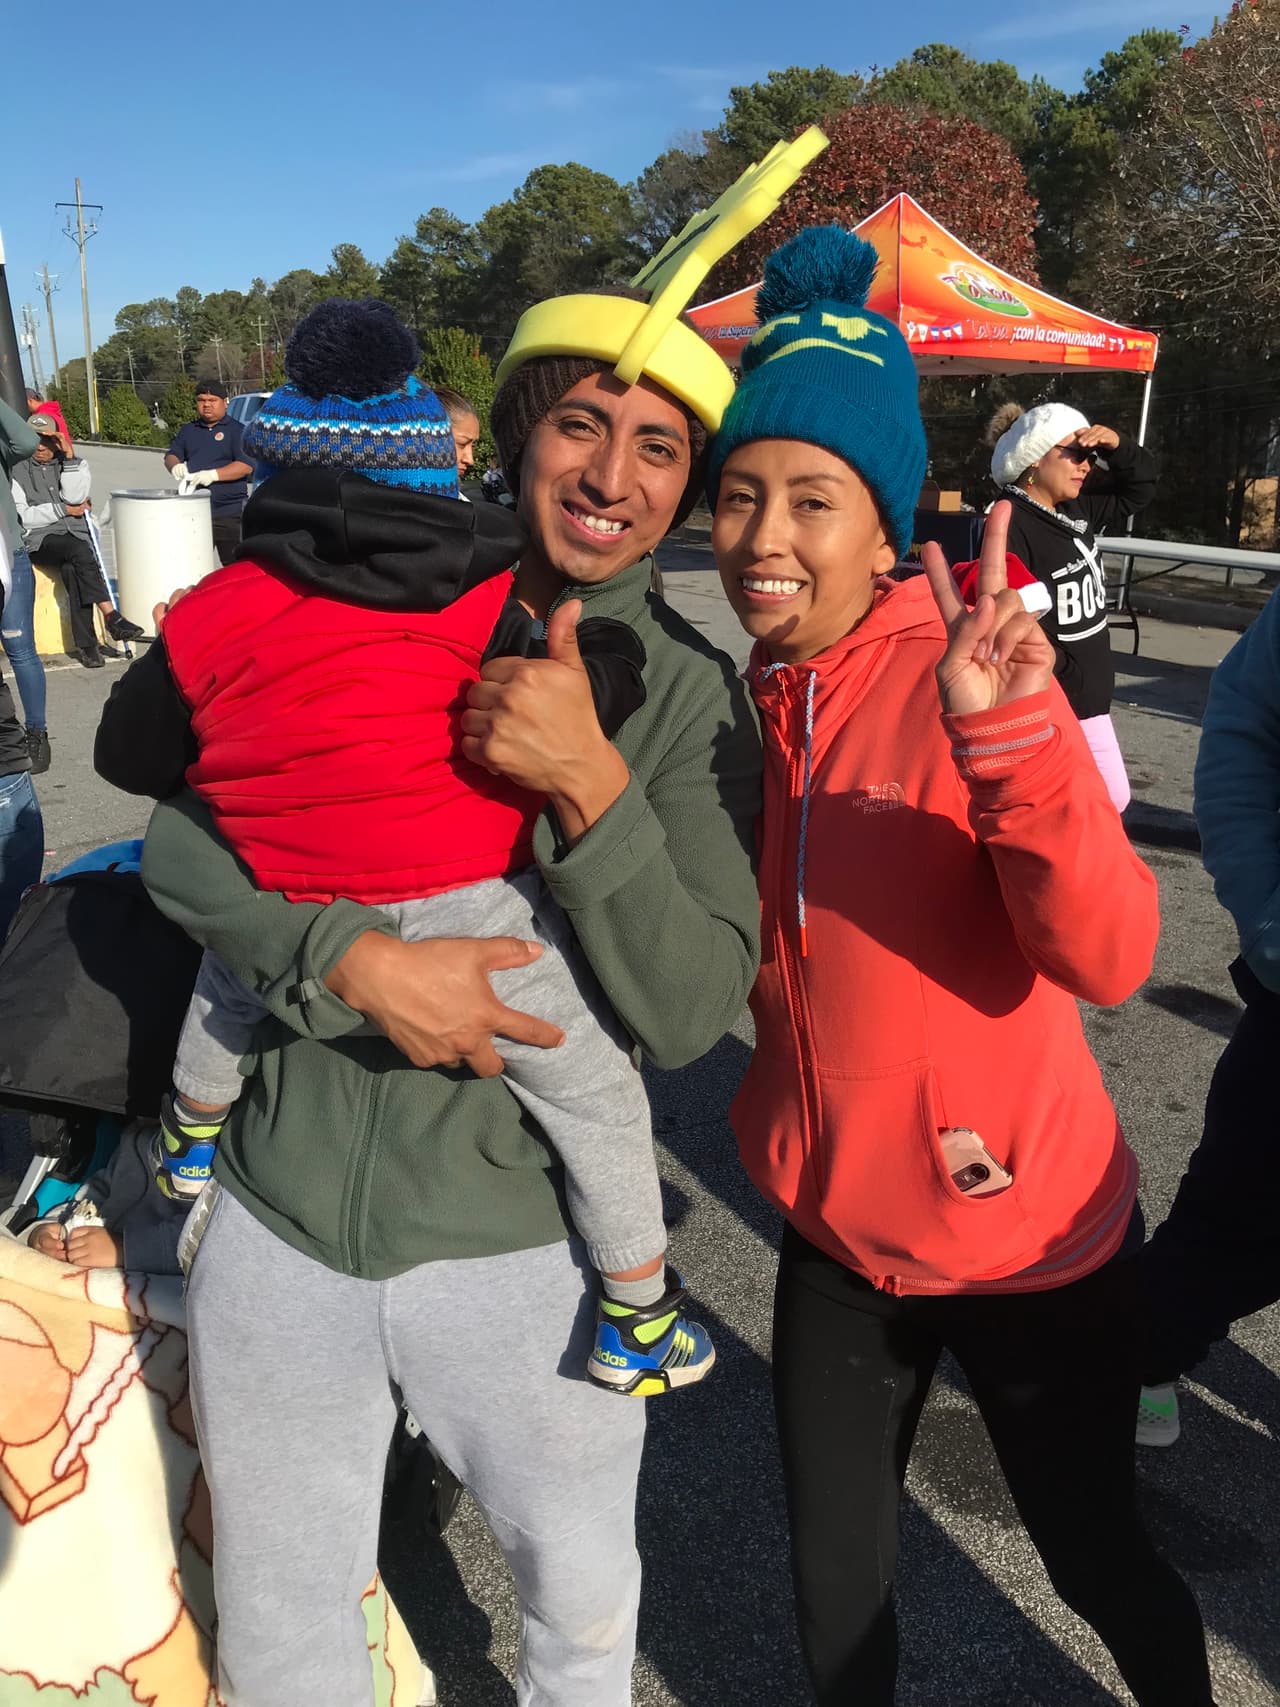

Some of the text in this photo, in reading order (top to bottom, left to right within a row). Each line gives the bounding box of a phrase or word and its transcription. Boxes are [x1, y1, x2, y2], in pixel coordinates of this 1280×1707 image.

[1034, 324, 1045, 341] la
[866, 783, 889, 793] THE
[852, 791, 889, 809] NORTH
[863, 801, 888, 815] FACE
